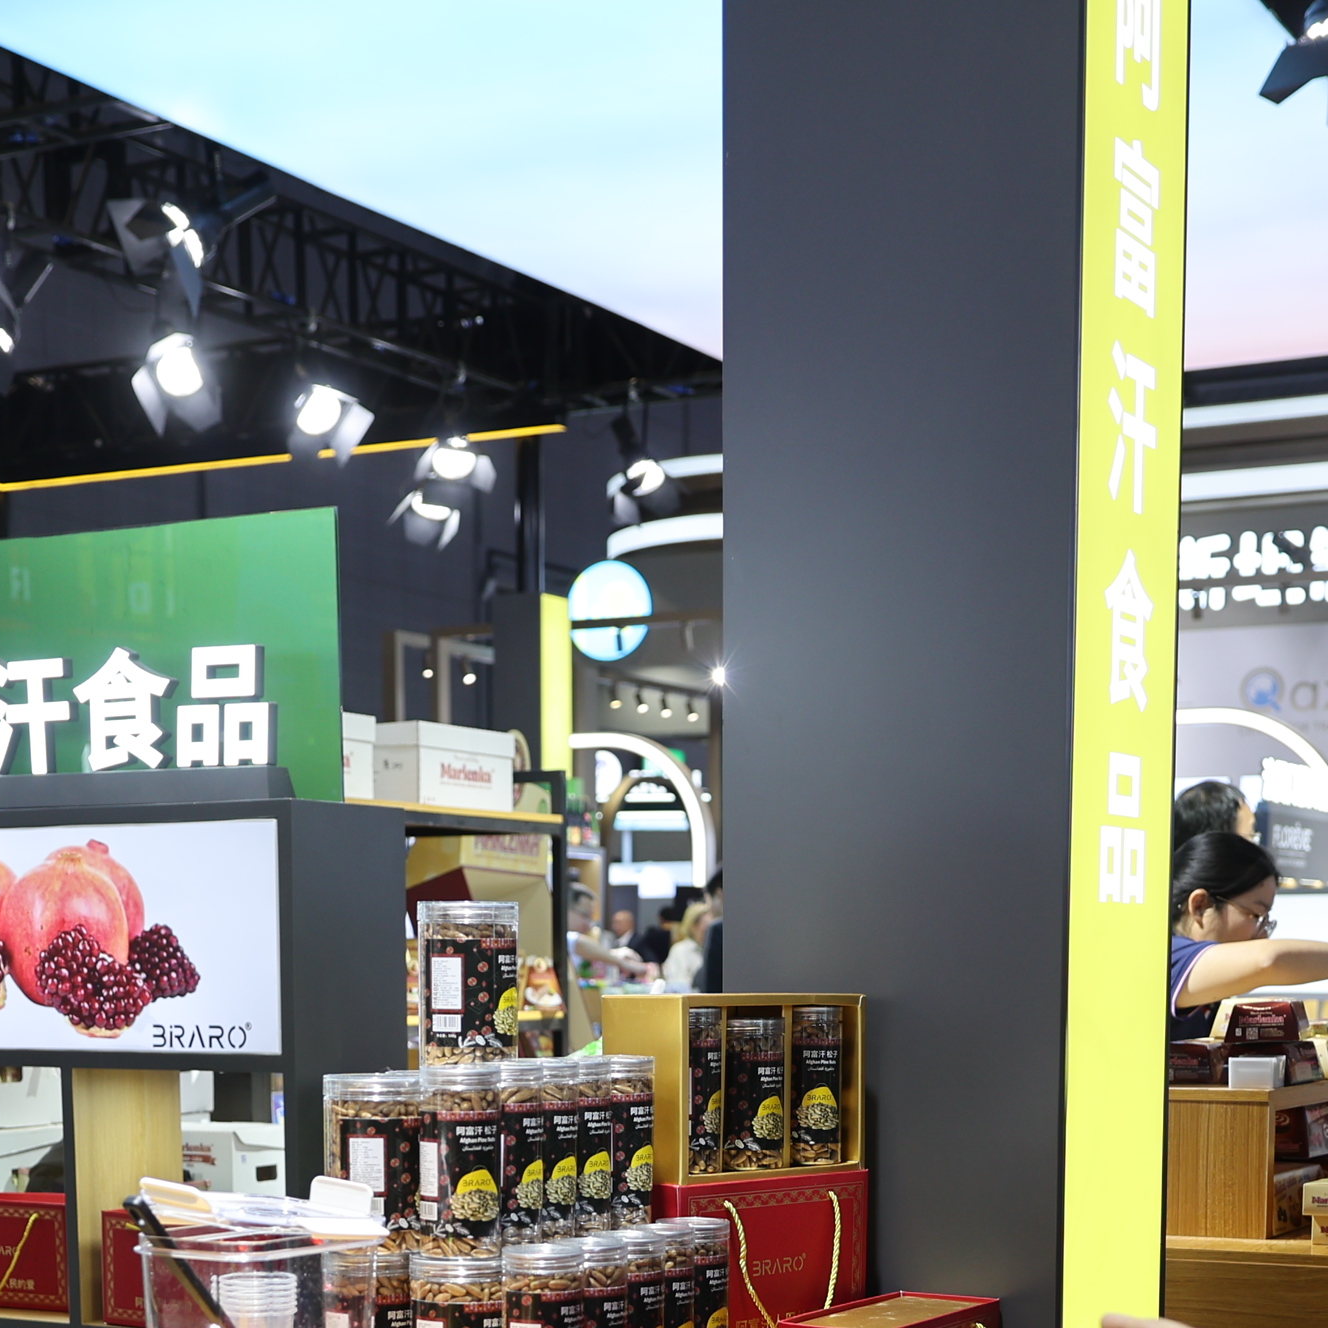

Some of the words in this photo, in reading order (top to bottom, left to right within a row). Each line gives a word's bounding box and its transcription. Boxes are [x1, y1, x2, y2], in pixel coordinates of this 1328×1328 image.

[1098, 0, 1162, 904] 阿富汗食品
[440, 762, 492, 784] Marlenka
[803, 1050, 825, 1058] 阿富汗
[456, 1126, 483, 1136] 阿富汗
